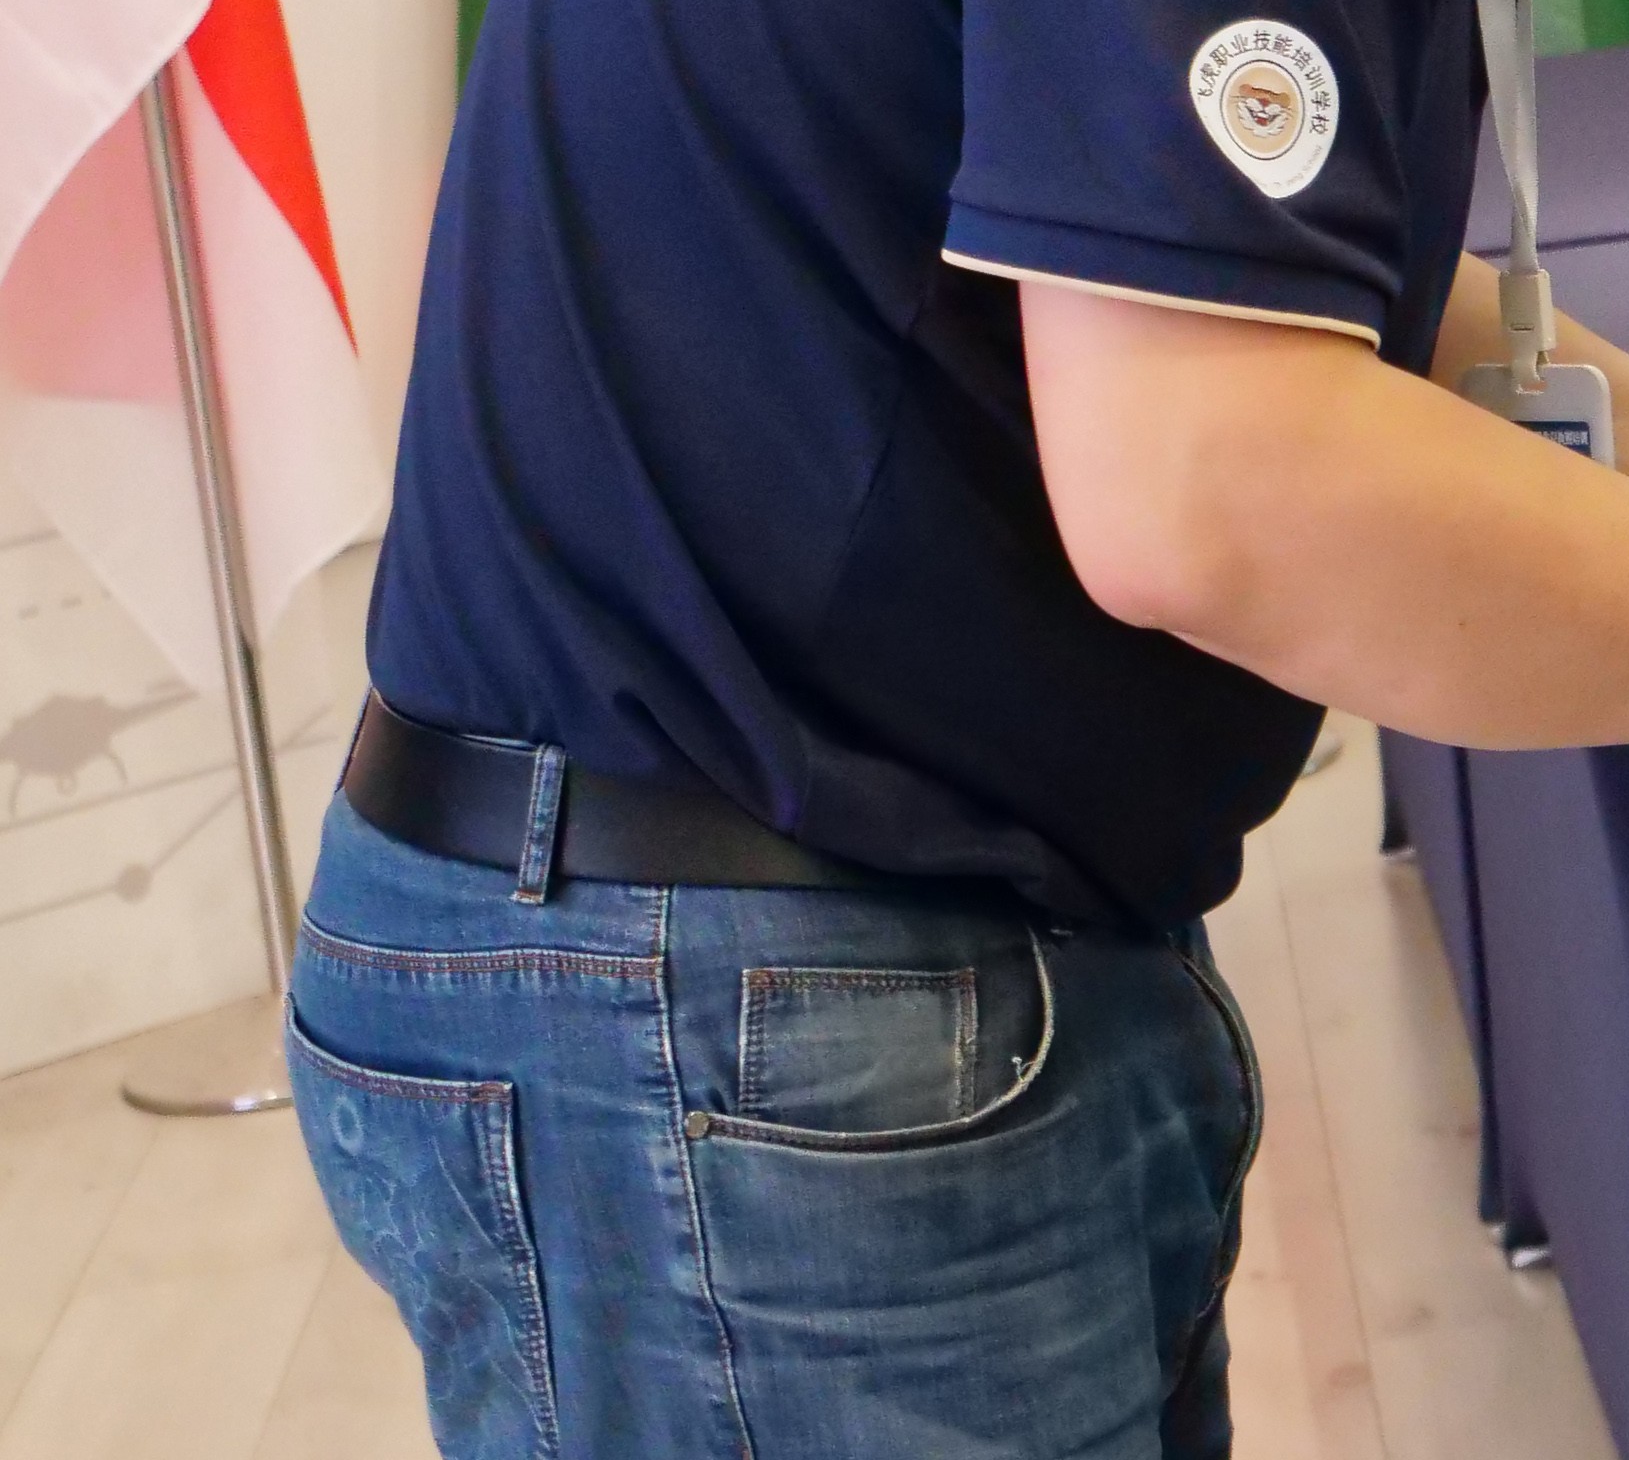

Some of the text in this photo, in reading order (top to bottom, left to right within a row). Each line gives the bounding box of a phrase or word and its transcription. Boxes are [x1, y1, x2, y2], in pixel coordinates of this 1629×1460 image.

[1197, 29, 1332, 135] 飞虎职业技能培训学校
